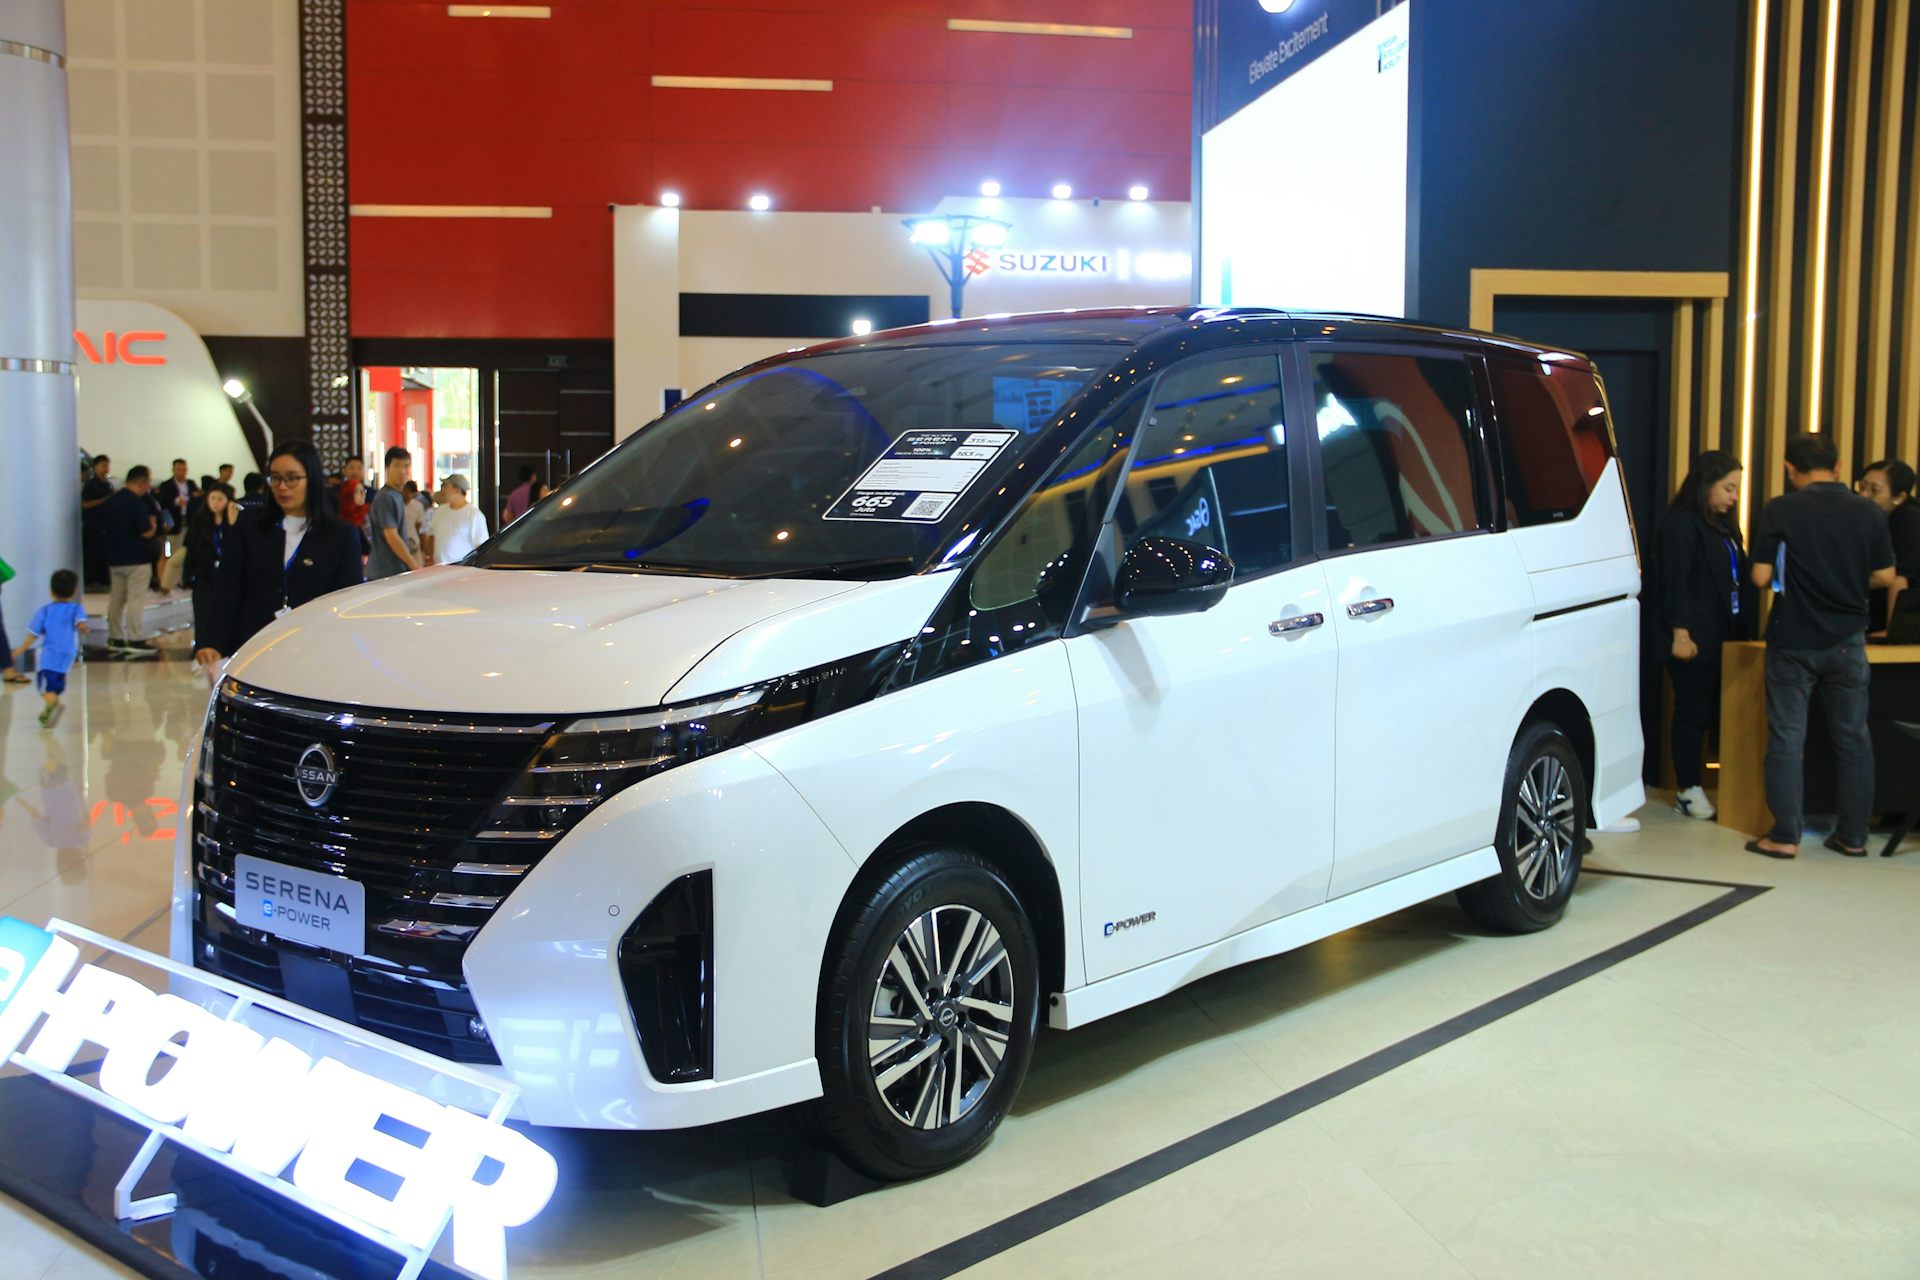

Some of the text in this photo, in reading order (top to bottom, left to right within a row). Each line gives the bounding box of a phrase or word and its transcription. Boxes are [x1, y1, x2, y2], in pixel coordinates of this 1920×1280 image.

[1249, 12, 1328, 84] Elevate Excitement
[999, 253, 1108, 273] SUZUKI
[851, 496, 897, 508] 665
[245, 871, 351, 915] SERENA
[263, 899, 331, 931] e-POWER
[1103, 910, 1157, 937] e-POWER
